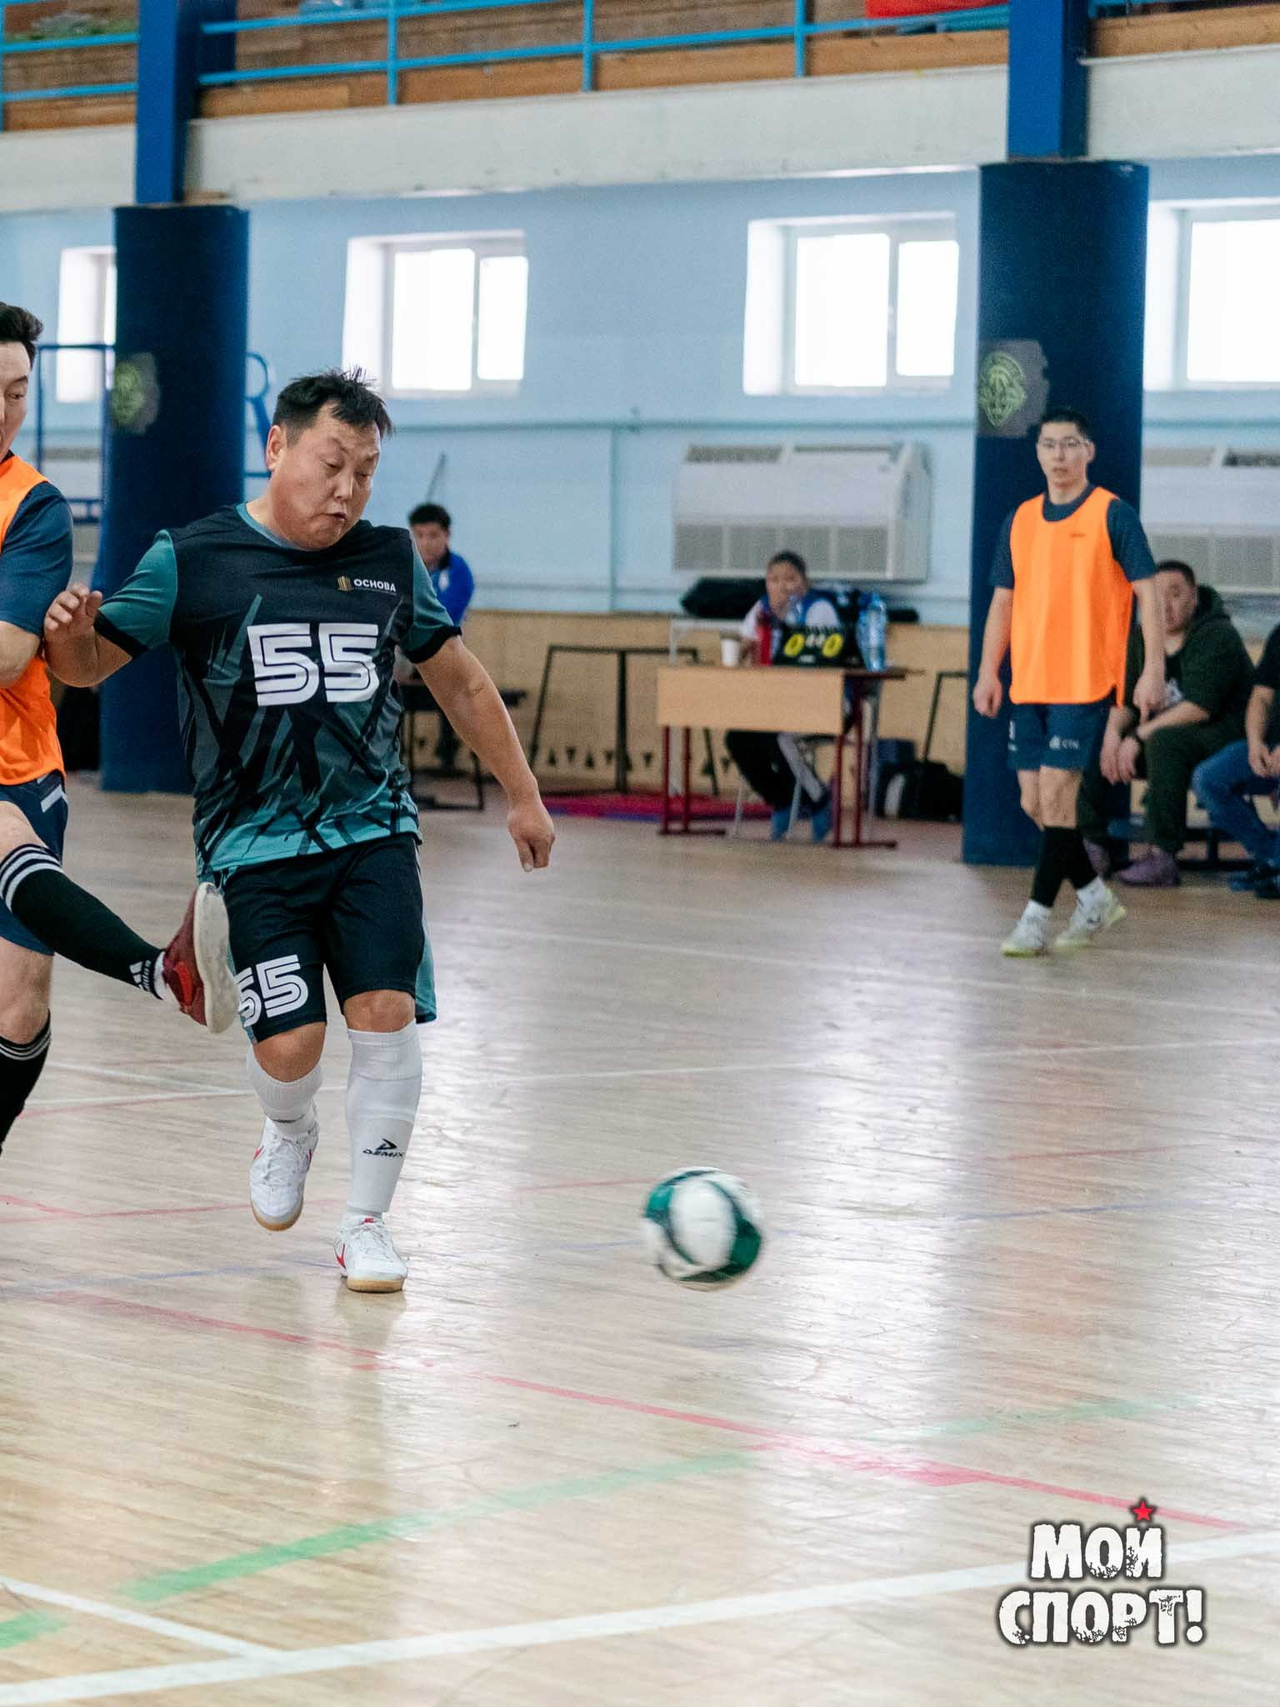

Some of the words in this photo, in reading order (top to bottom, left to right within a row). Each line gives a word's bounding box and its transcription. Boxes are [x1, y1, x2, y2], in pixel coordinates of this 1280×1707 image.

[353, 578, 397, 593] ОСНОВА
[247, 623, 380, 706] 55
[235, 954, 309, 1028] 55
